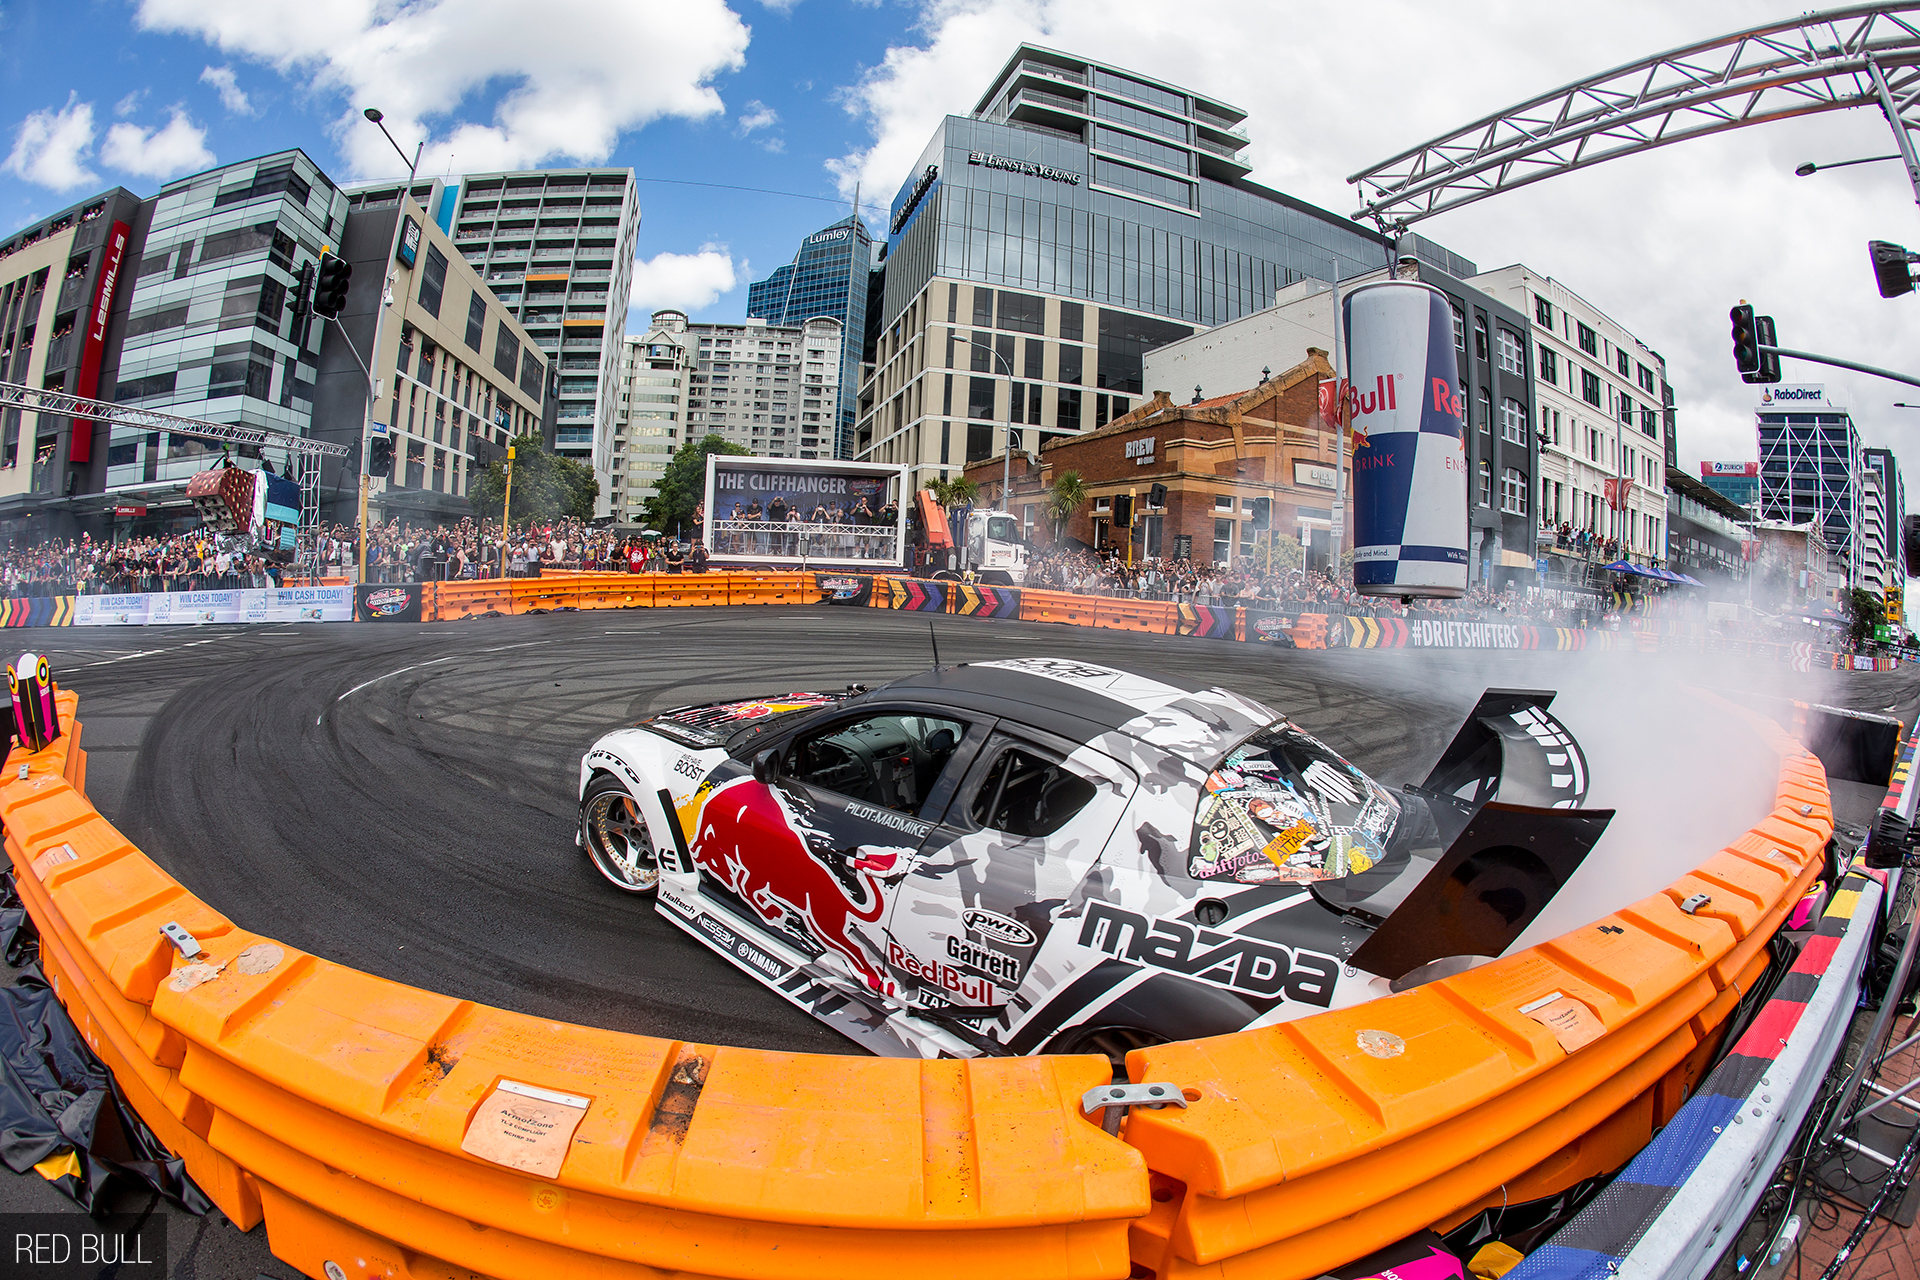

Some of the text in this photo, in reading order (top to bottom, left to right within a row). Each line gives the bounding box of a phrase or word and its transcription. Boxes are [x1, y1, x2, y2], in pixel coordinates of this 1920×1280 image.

[1038, 163, 1081, 185] YOUNG
[810, 229, 850, 244] Lumley
[1351, 374, 1396, 420] Bull
[1432, 377, 1462, 418] Re
[1774, 388, 1821, 400] RaboDirect
[1125, 436, 1155, 458] BREW
[1356, 453, 1395, 472] DRINK
[718, 472, 847, 494] THE CLIFFHANGER
[1311, 469, 1335, 479] BREW
[100, 596, 143, 605] WIN CASH TODAY!
[180, 593, 233, 603] WIN CASH TODAY!
[278, 589, 343, 600] WIN CASH TODAY!
[1412, 620, 1519, 648] #DRIFTSHIFTERS
[674, 760, 705, 781] BOOST
[1220, 790, 1292, 800] SPEEDHUNTERS
[844, 802, 930, 838] PILOT:MADMIKE
[1277, 827, 1312, 859] ATTACK
[662, 890, 696, 914] Haltech
[969, 911, 1026, 936] PWR
[747, 947, 782, 978] YAMAHA
[948, 936, 1018, 982] Garrett
[513, 1123, 547, 1137] COMPLIANT
